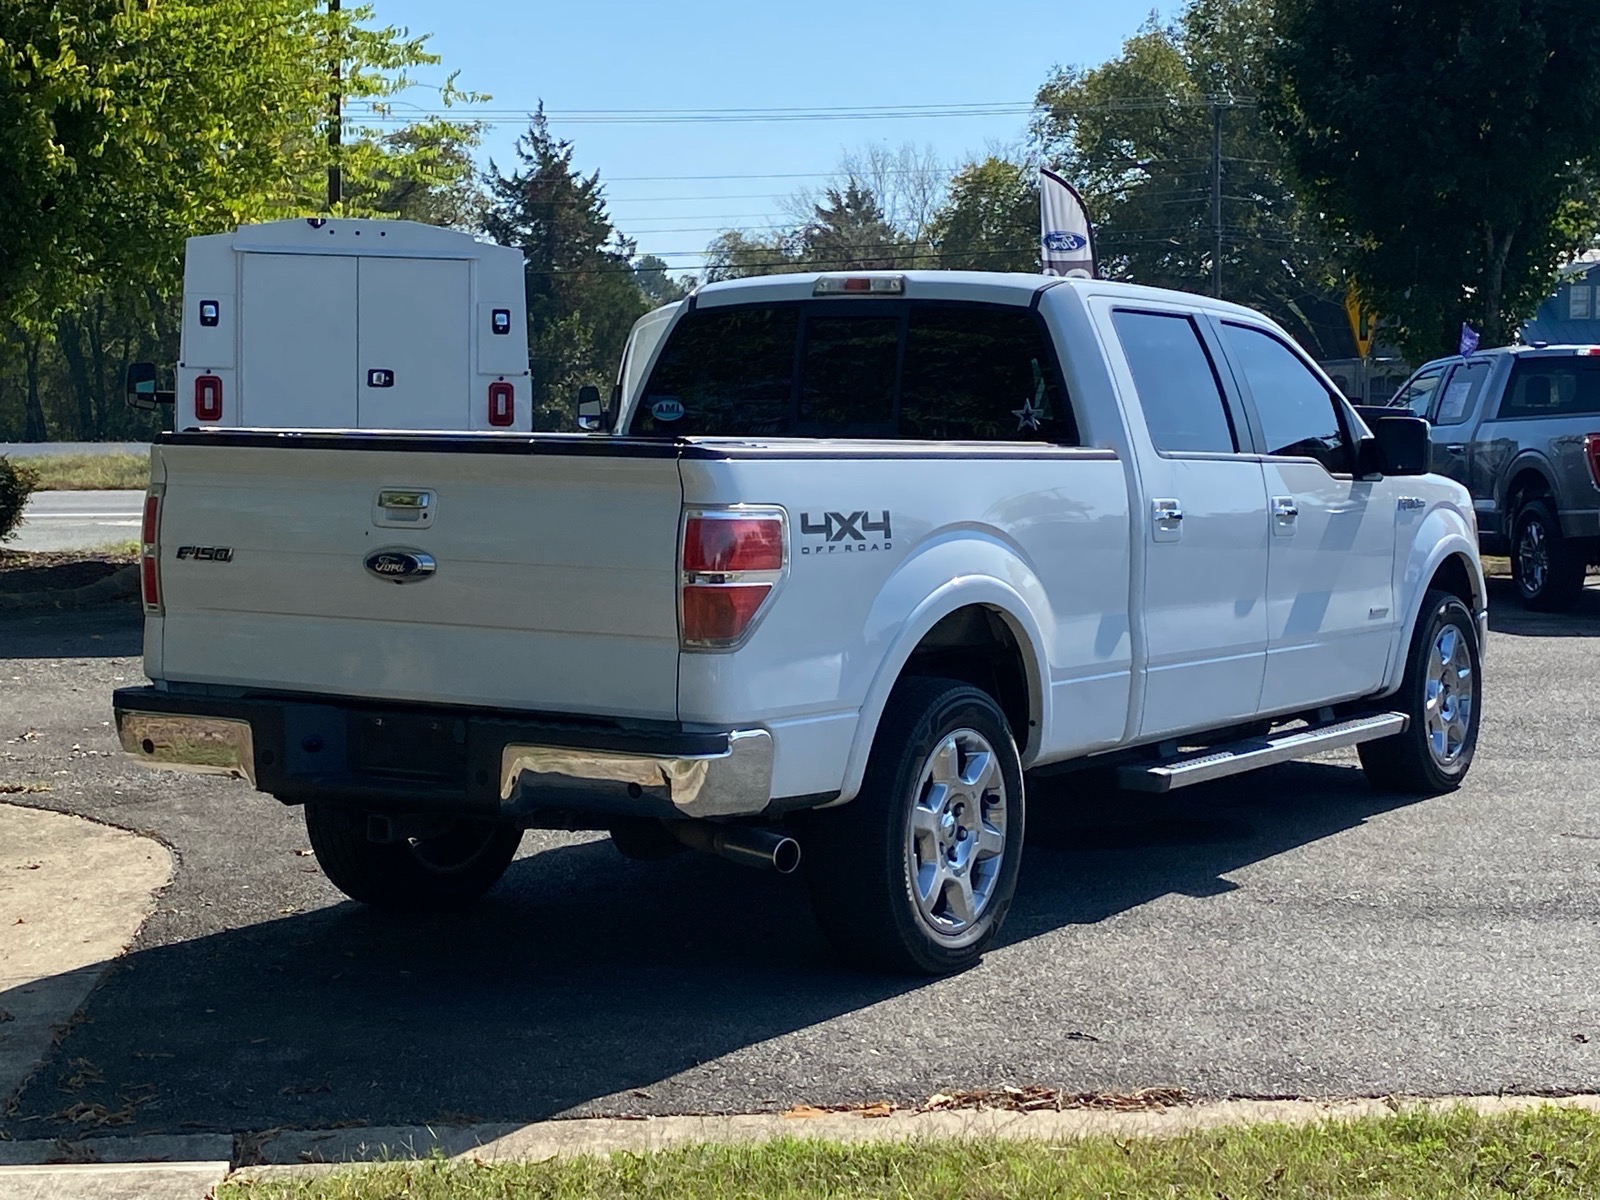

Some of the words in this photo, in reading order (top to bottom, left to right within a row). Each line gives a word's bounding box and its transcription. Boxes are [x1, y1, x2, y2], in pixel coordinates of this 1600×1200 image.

[801, 545, 837, 555] OFF
[844, 542, 892, 552] ROAD
[375, 555, 406, 572] Ford
